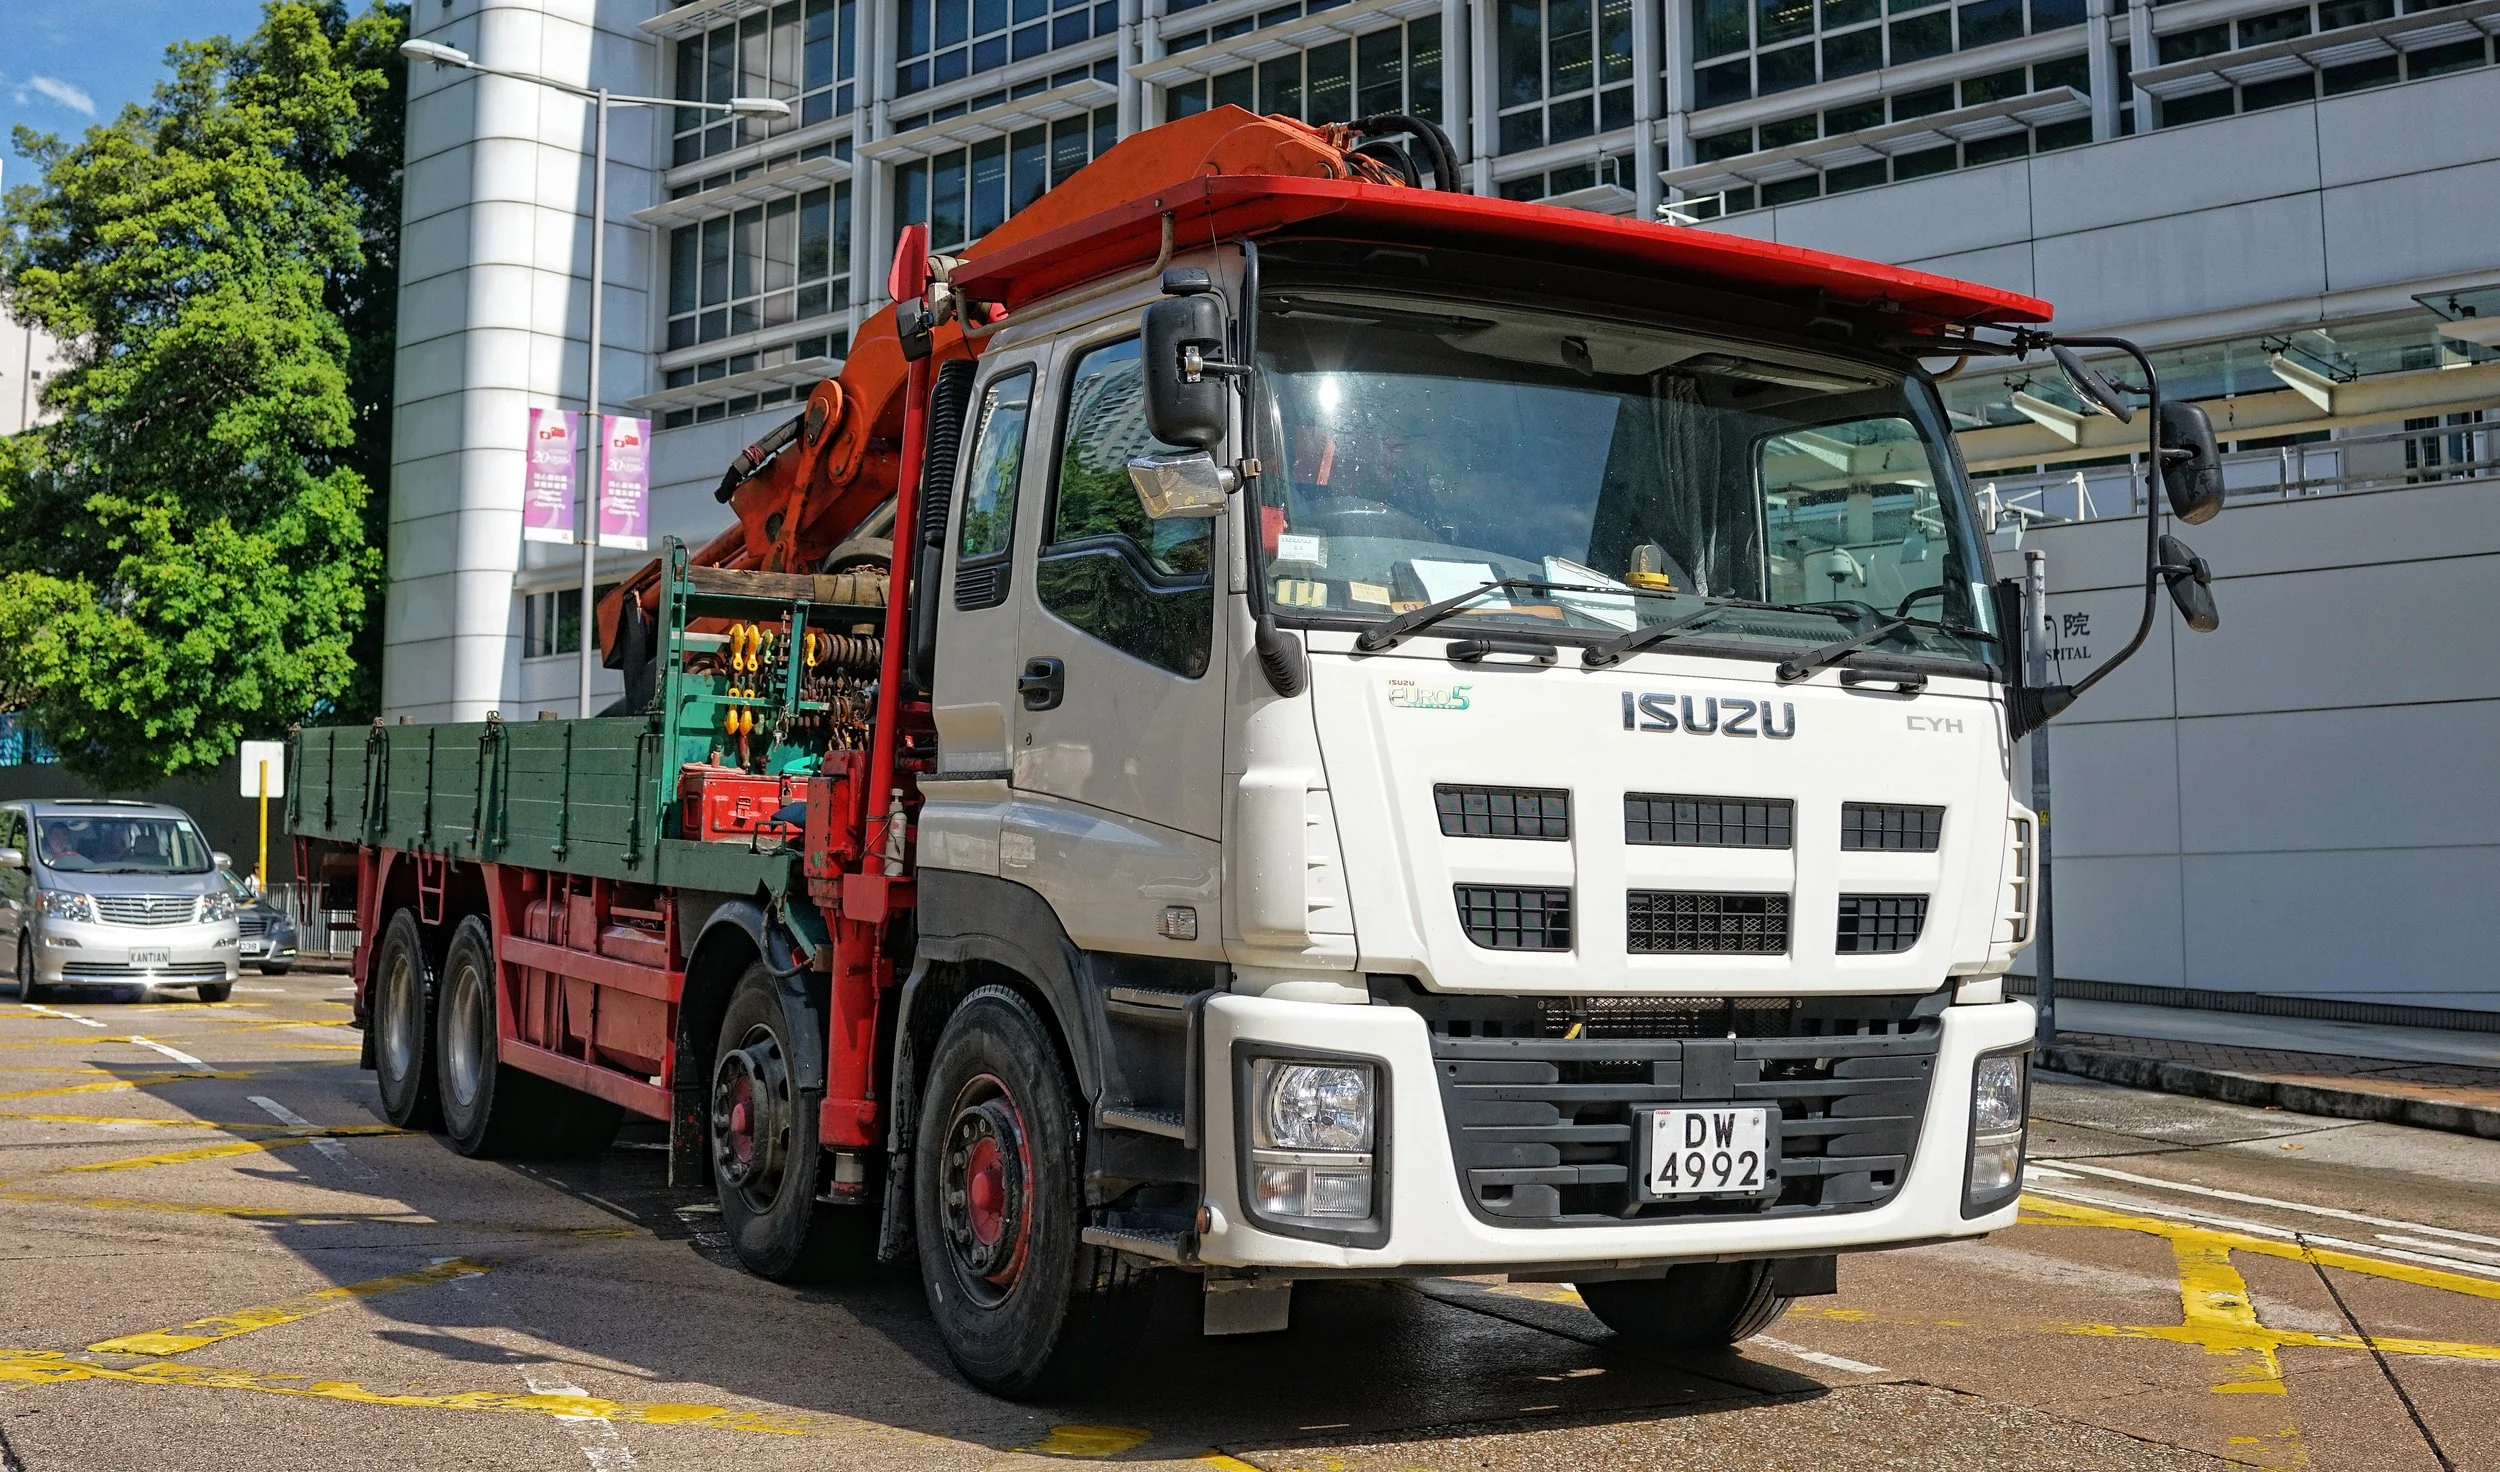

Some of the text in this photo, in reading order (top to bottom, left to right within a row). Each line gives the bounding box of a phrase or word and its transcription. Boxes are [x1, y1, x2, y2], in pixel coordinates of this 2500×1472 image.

[2026, 646, 2092, 662] SPITAL
[1622, 691, 1796, 740] ISUZU
[1906, 715, 1964, 734] CYH
[130, 952, 168, 963] KANTIAN
[1685, 1113, 1736, 1149] DW
[1657, 1151, 1759, 1188] 4992
